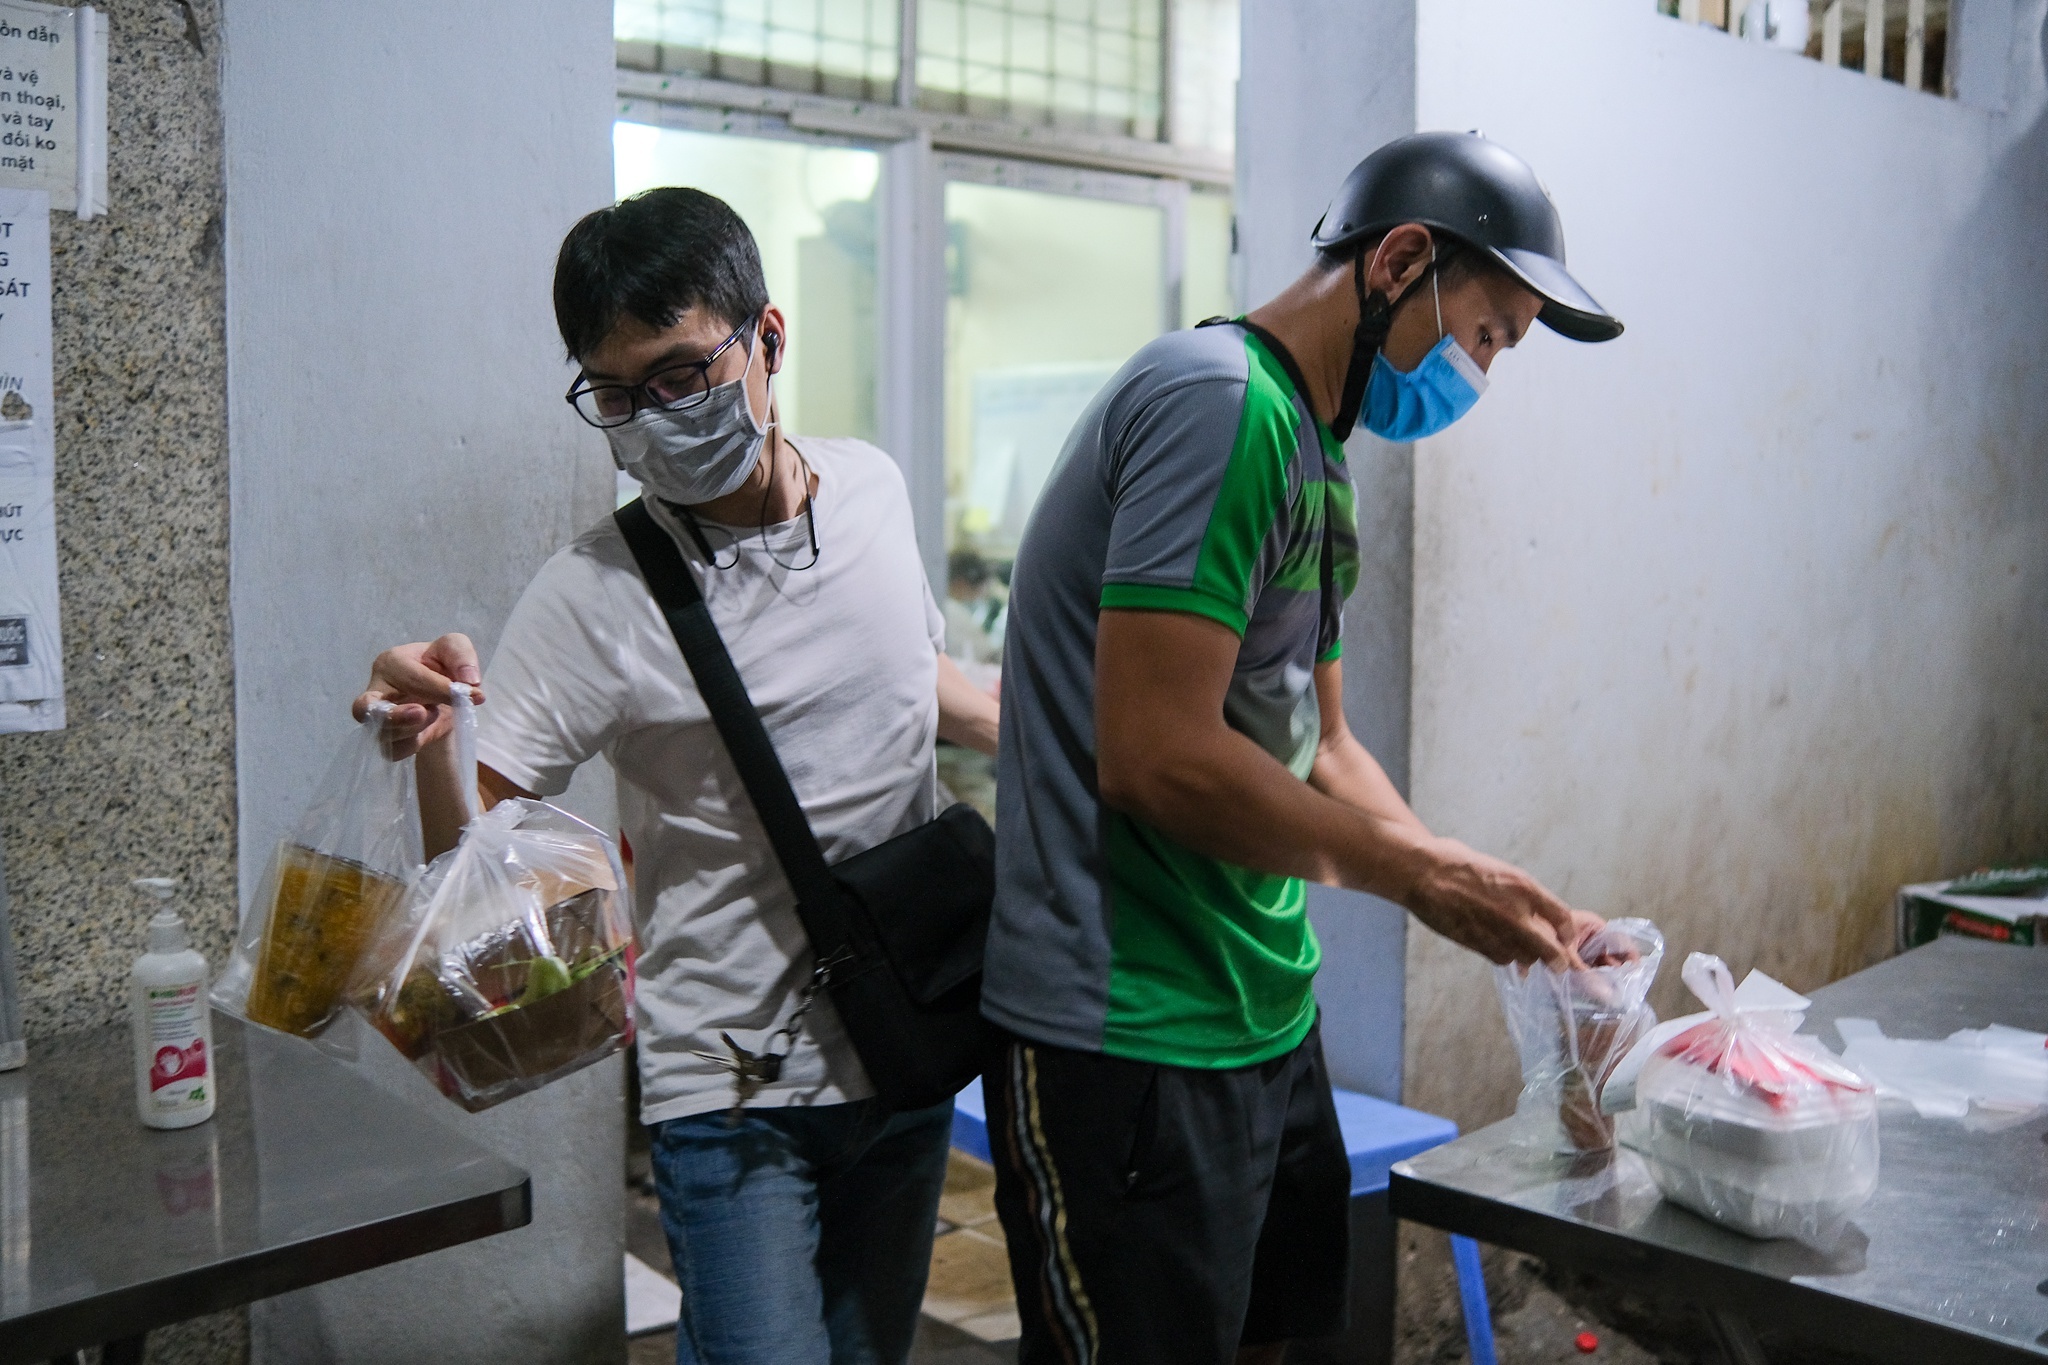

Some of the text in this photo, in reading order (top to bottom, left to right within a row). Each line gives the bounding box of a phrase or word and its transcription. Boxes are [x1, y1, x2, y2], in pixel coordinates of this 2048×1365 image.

[19, 70, 39, 87] vệ
[17, 91, 65, 111] thoại,
[1, 111, 53, 131] và tay
[3, 130, 56, 150] đối ko
[1, 155, 35, 172] mặt
